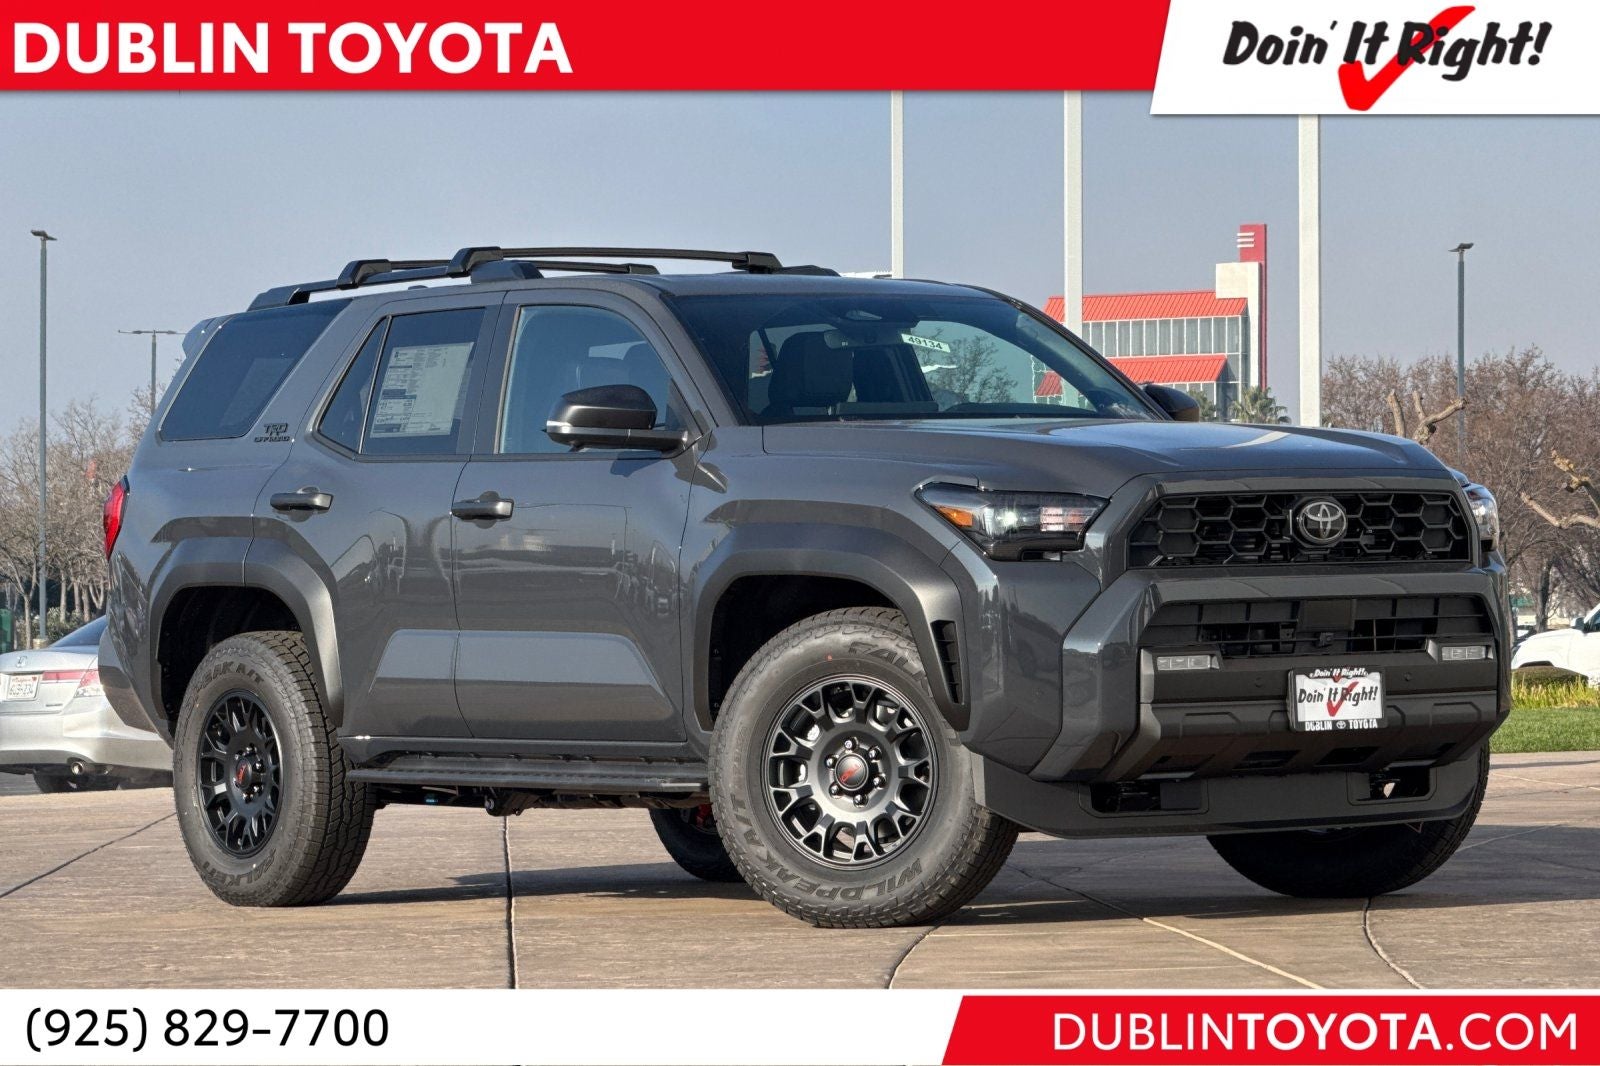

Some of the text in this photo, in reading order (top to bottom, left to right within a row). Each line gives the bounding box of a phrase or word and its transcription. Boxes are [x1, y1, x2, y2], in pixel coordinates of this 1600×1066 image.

[908, 336, 942, 350] 49134
[264, 422, 289, 436] TRD
[1333, 668, 1341, 676] It
[1328, 687, 1338, 702] It
[1341, 686, 1379, 707] Right!
[1305, 718, 1378, 732] DUBLIN TOYOTA
[758, 851, 923, 902] WILDPEAK
